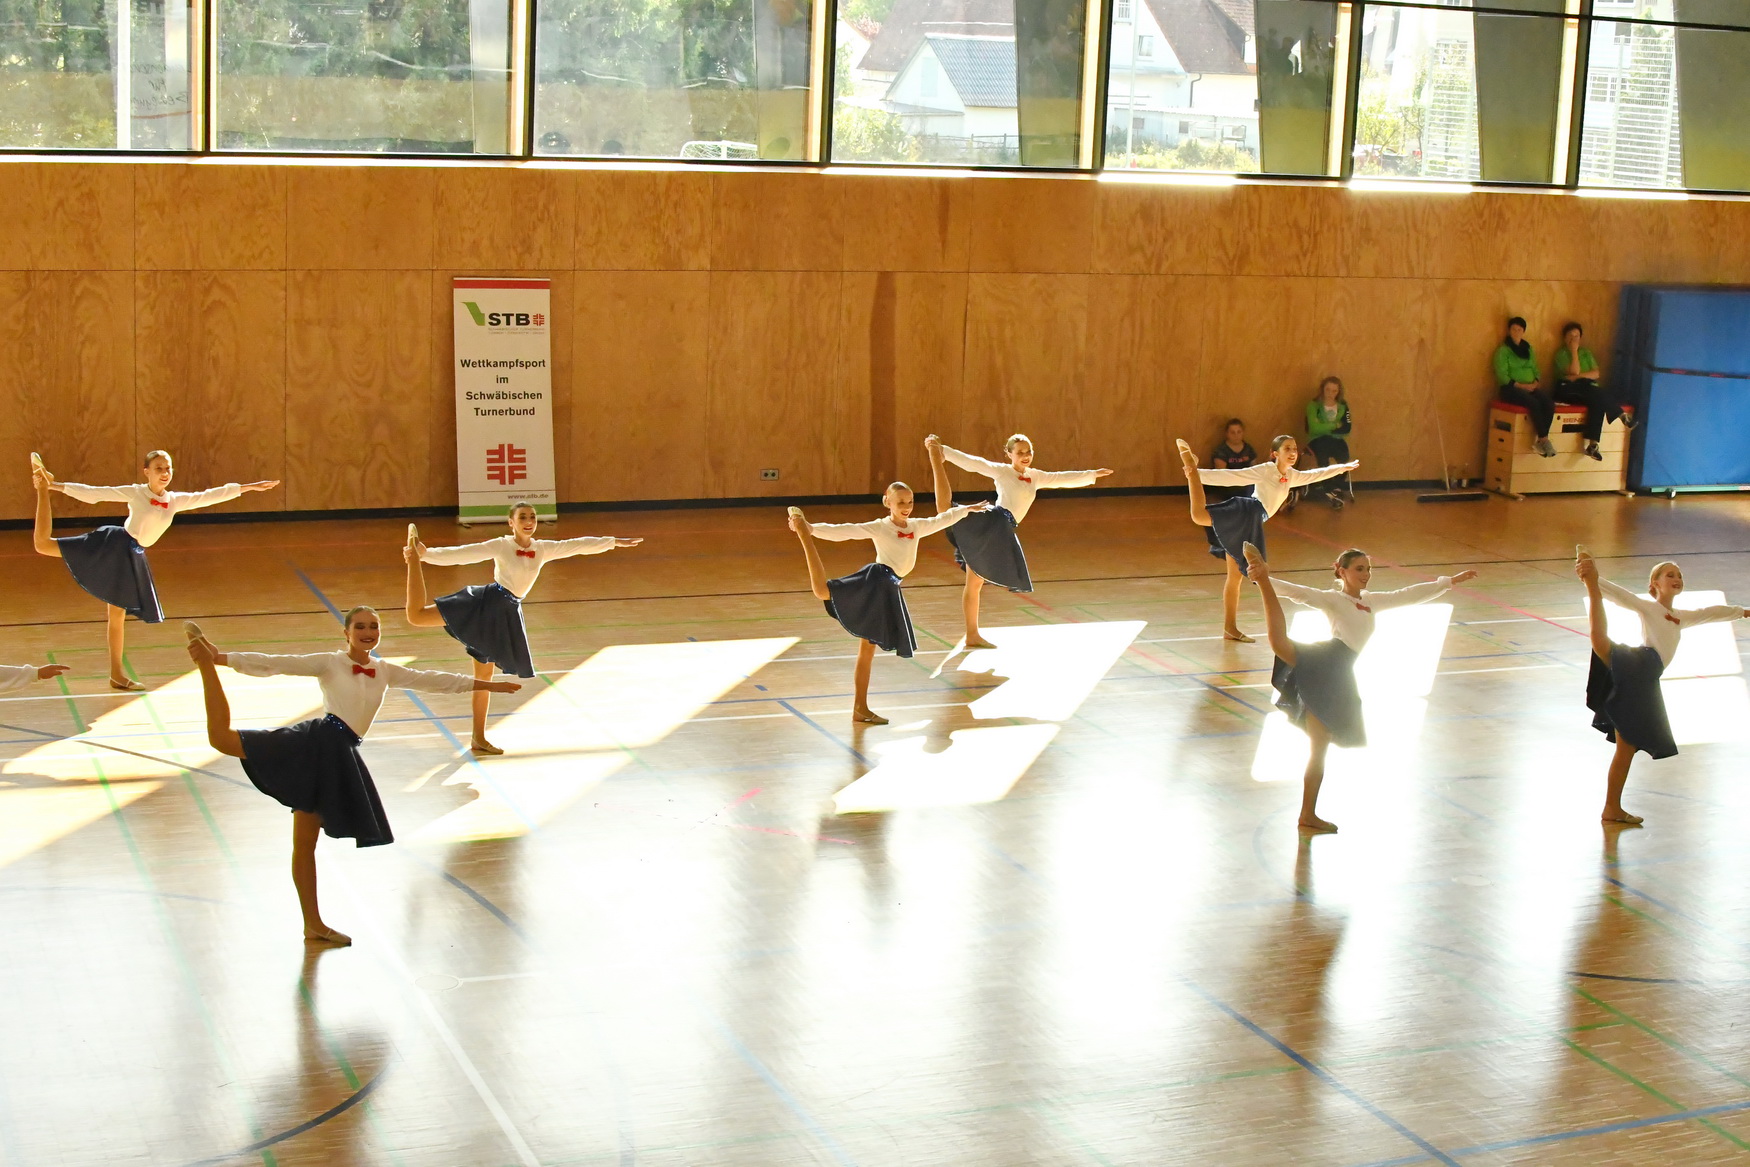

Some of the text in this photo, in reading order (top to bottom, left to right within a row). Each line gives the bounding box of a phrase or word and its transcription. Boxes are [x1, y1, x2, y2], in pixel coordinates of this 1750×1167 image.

[488, 312, 531, 326] STB
[460, 358, 546, 370] Wettkampfsport
[496, 375, 509, 384] im
[465, 390, 543, 400] Schwäbischen
[474, 407, 535, 416] Turnerbund
